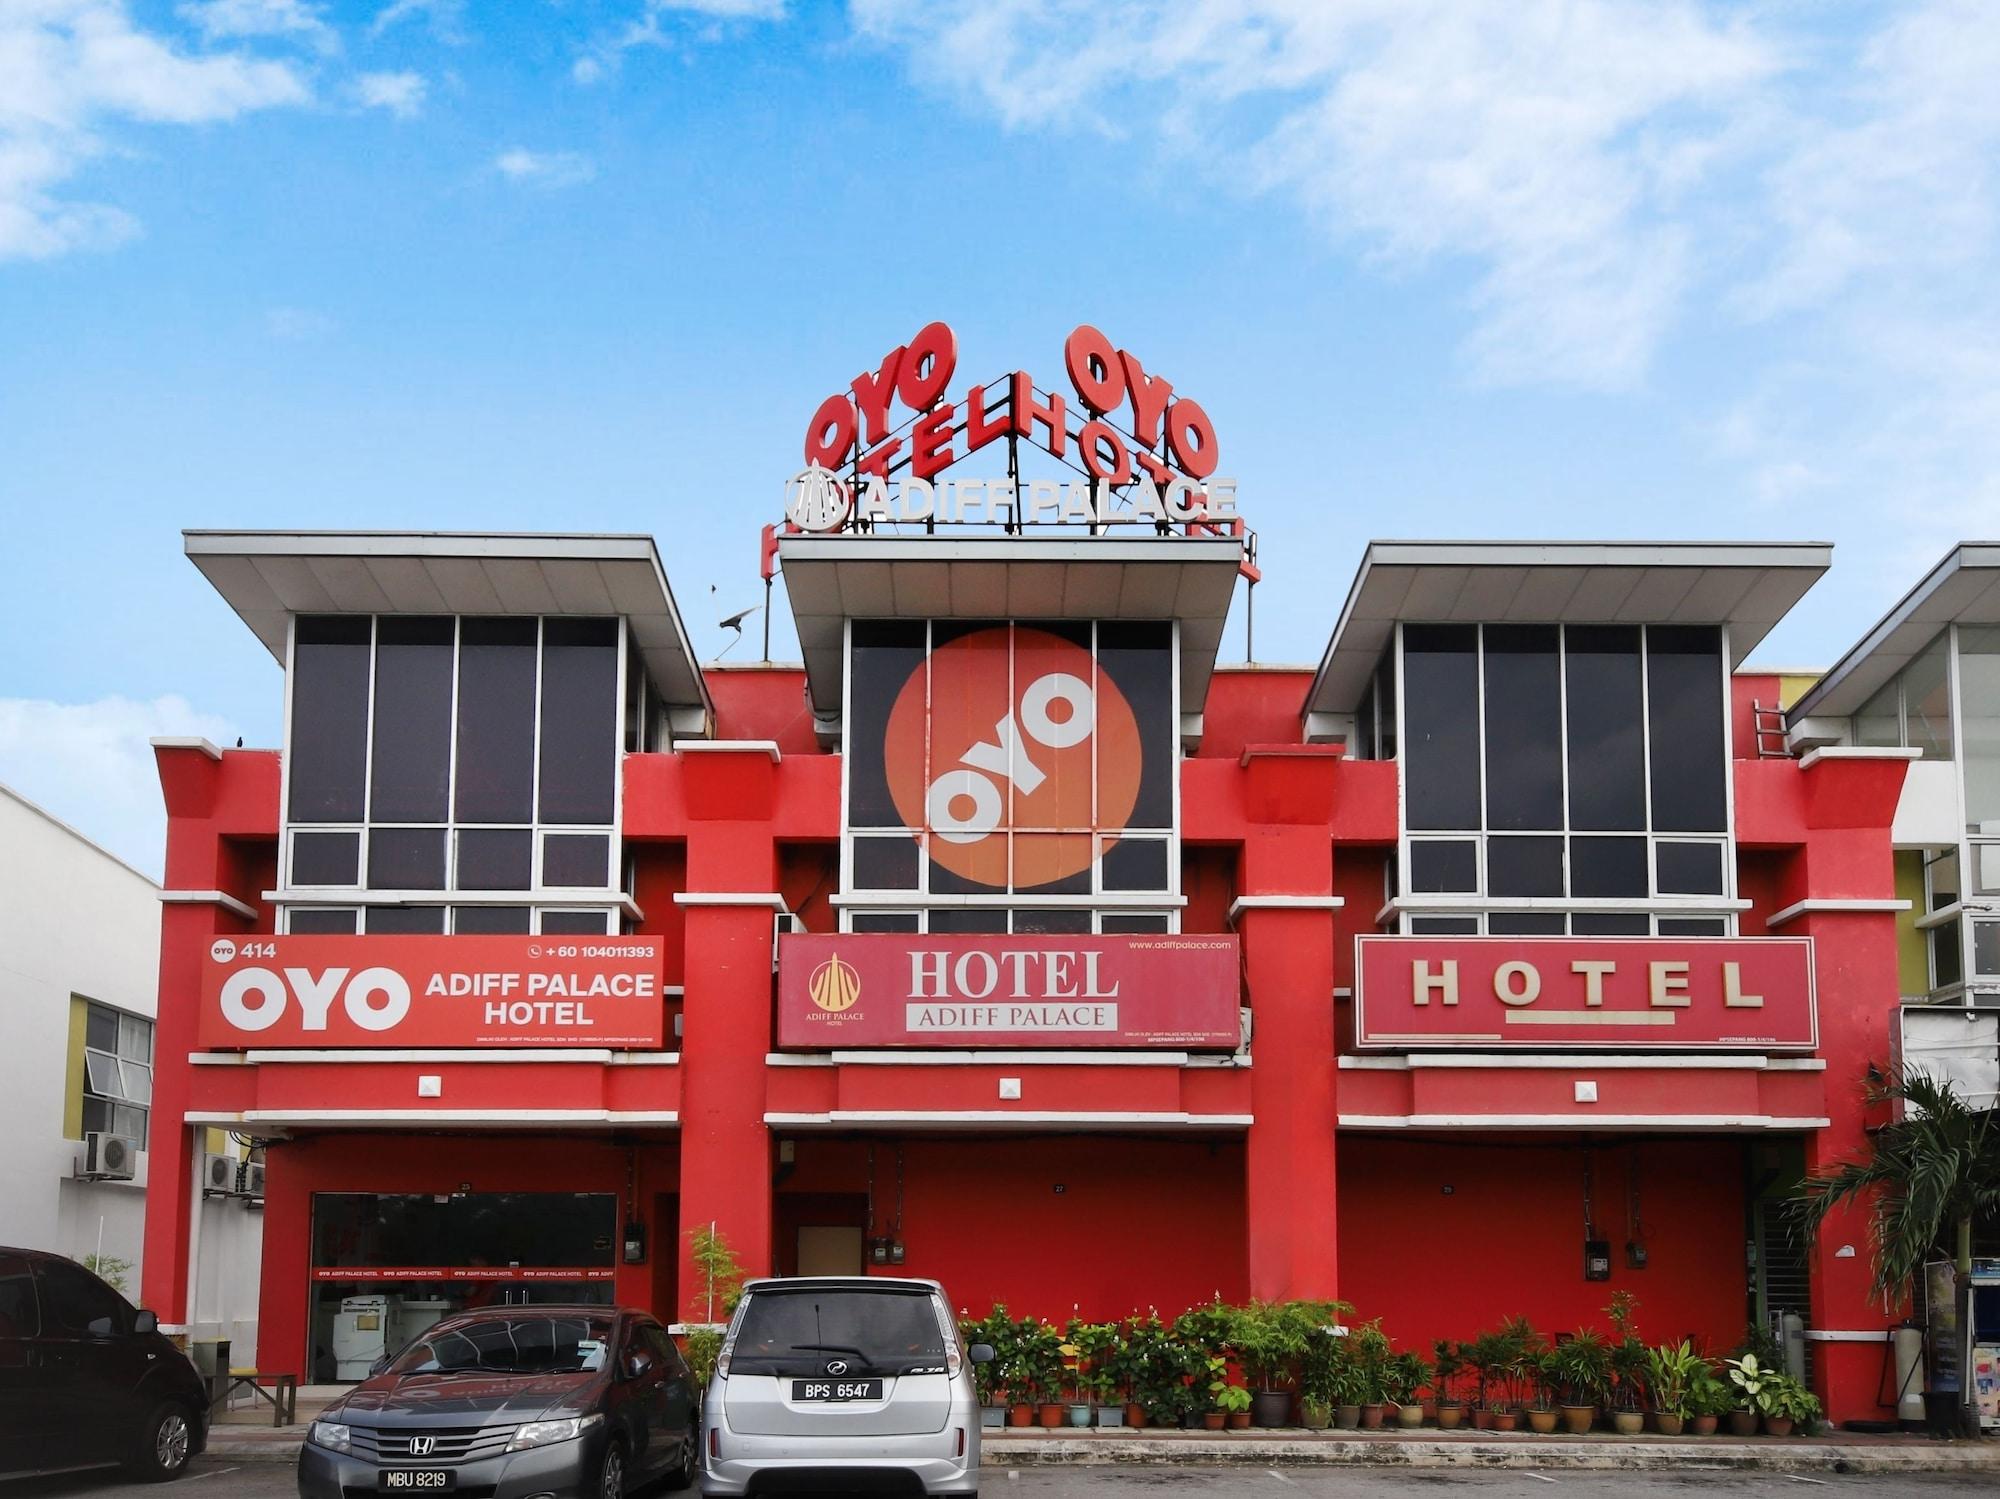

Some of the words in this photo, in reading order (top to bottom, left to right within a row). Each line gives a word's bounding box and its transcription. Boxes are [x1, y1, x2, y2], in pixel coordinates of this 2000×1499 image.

[804, 321, 959, 472] OYO
[1065, 324, 1219, 480] OYO
[862, 476, 1013, 524] ADIFF
[1029, 477, 1239, 524] PALACE
[925, 672, 1096, 844] OYO
[214, 947, 234, 955] OYO
[240, 943, 276, 958] 414
[558, 946, 577, 958] 60
[581, 946, 654, 958] 104011393
[1129, 941, 1231, 950] www.adiffpalace.com
[424, 973, 521, 997] ADIFF
[527, 973, 655, 997] PALACE
[906, 951, 1119, 998] HOTEL
[1412, 959, 1765, 1008] HOTEL
[220, 966, 411, 1032] OYO
[484, 1002, 594, 1025] HOTEL
[806, 1013, 831, 1021] ADIFF
[833, 1012, 865, 1021] PALACE
[918, 1007, 998, 1026] ADIFF
[1010, 1007, 1105, 1026] PALACE
[805, 1384, 831, 1397] BPS
[837, 1383, 870, 1397] 6547
[387, 1471, 415, 1487] MBU
[416, 1471, 446, 1487] 8219
